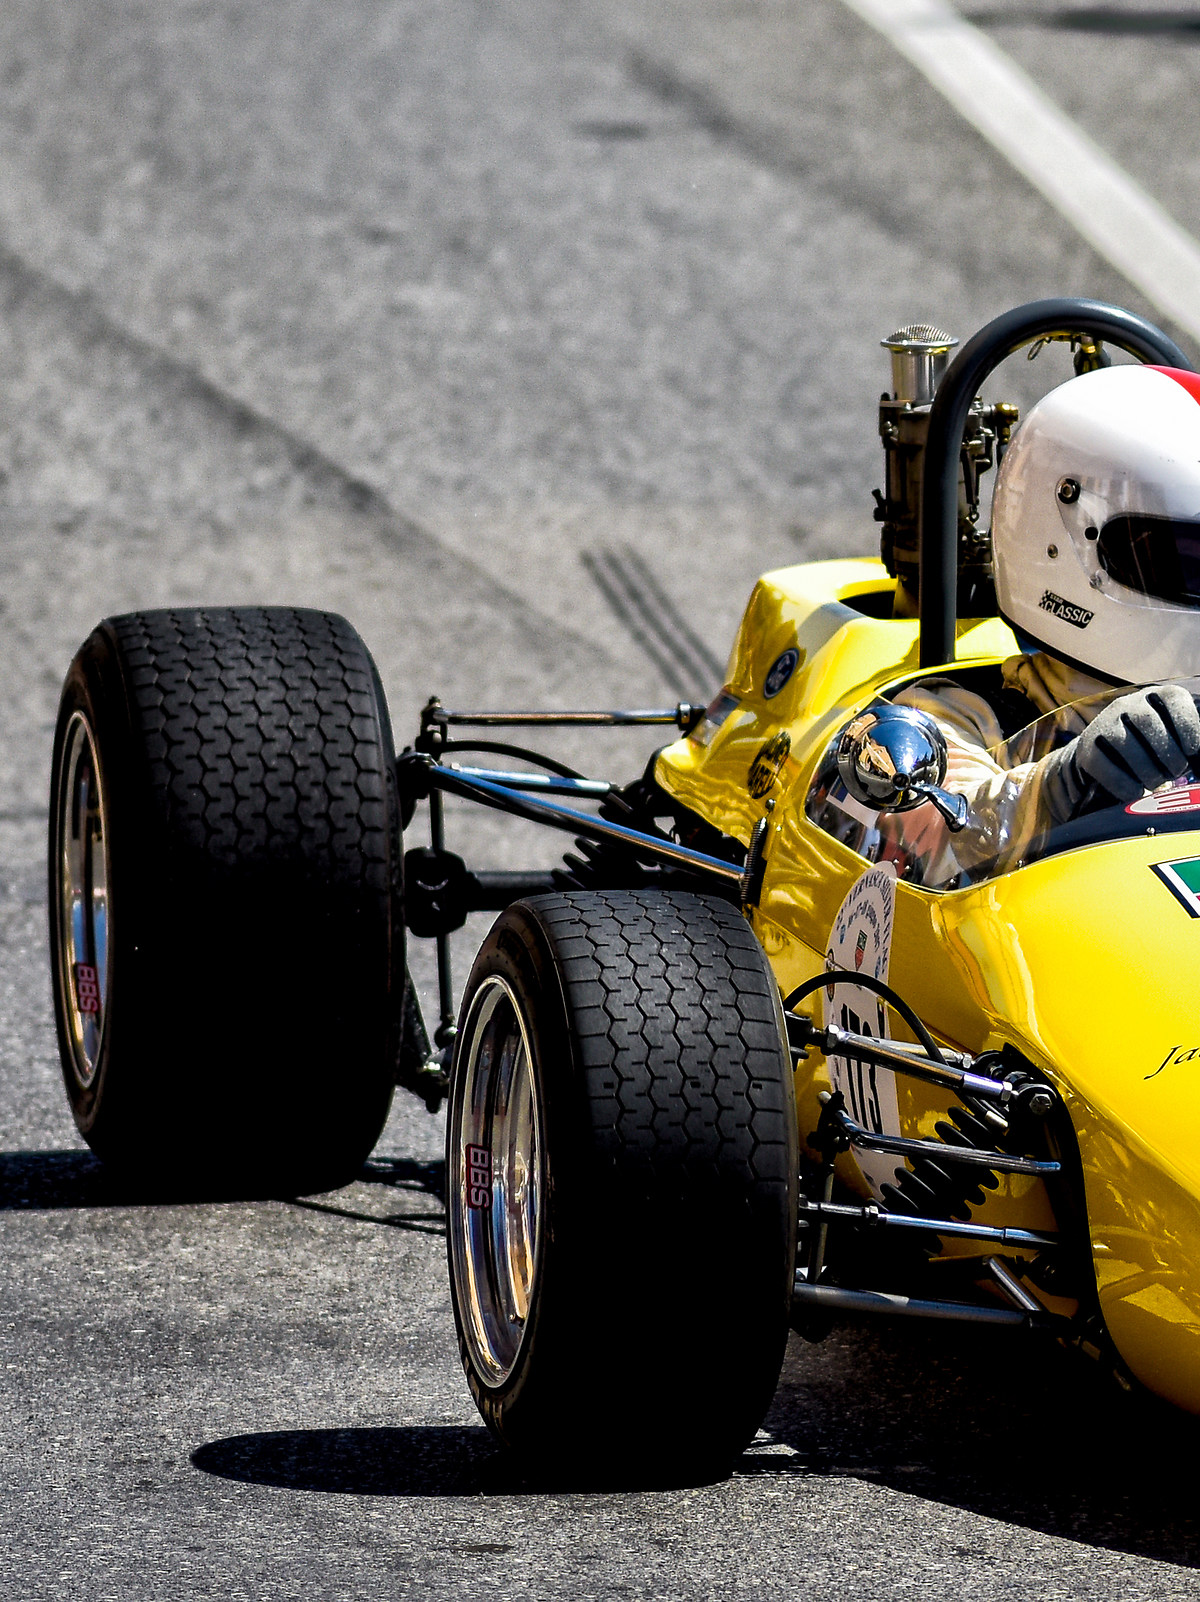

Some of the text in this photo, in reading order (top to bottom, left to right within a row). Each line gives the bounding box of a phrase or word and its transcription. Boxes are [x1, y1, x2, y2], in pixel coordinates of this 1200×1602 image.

[1044, 599, 1092, 624] CLASSIC
[76, 964, 99, 1012] BBS
[470, 1146, 490, 1209] BBS
